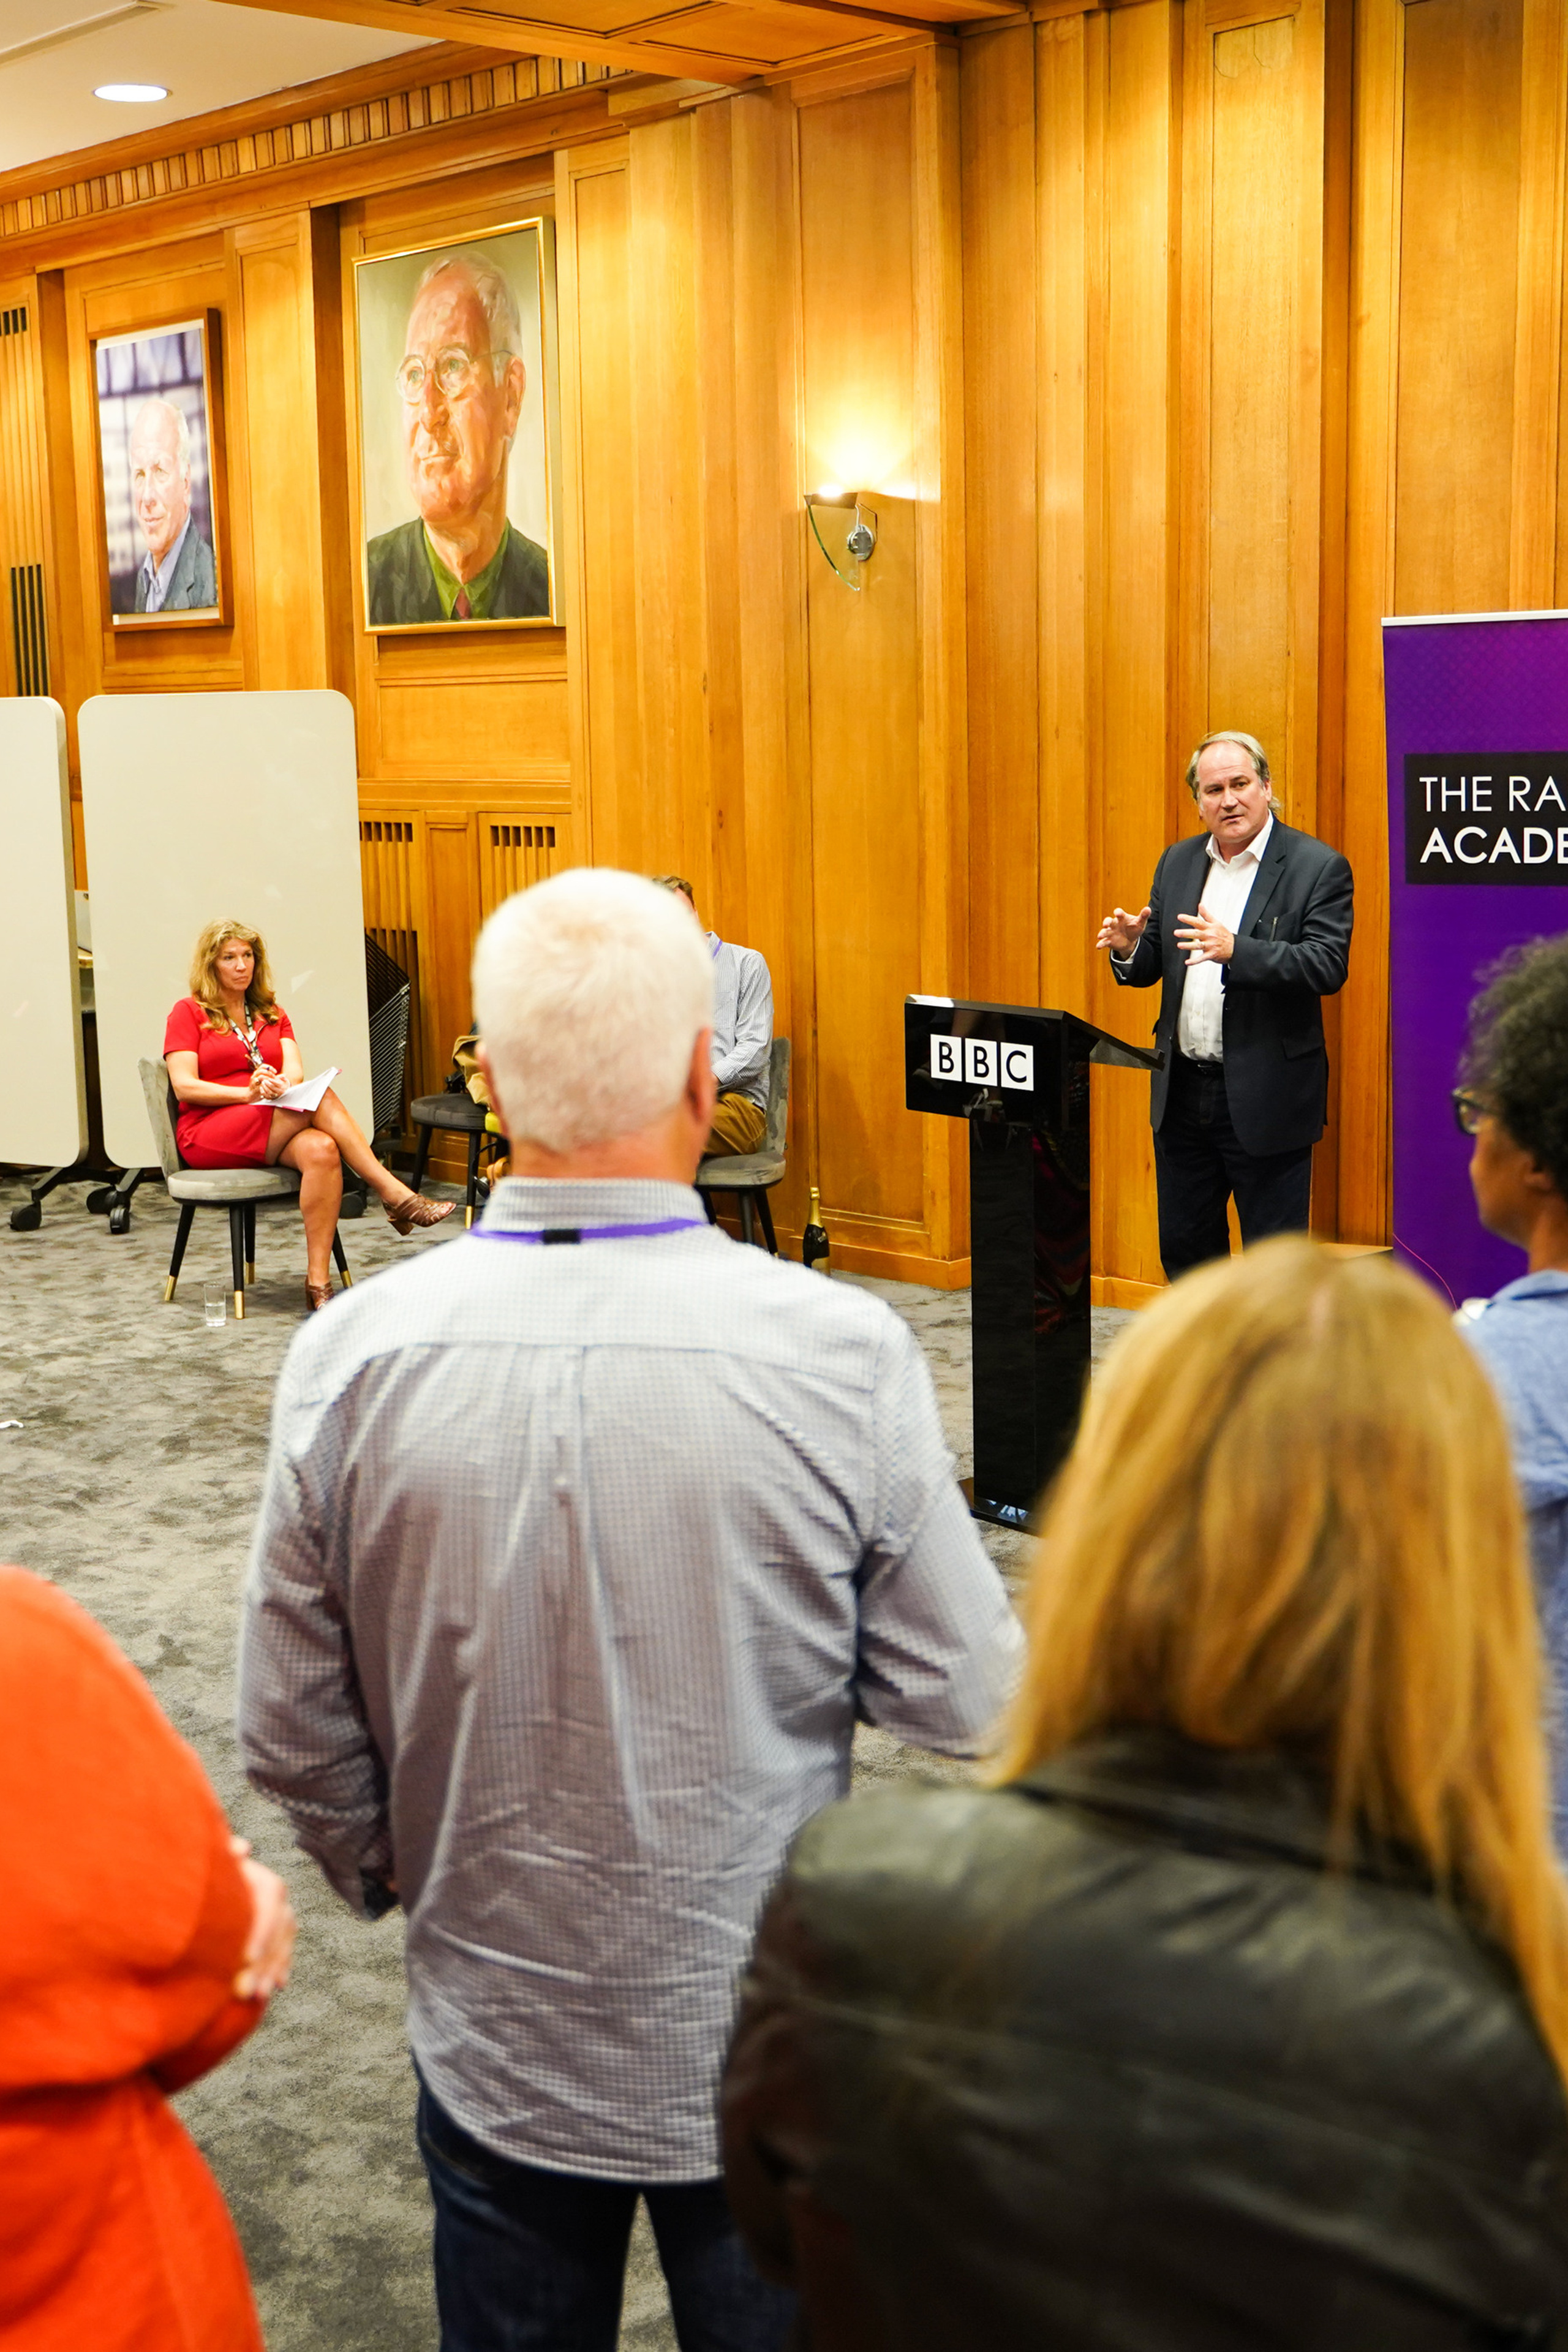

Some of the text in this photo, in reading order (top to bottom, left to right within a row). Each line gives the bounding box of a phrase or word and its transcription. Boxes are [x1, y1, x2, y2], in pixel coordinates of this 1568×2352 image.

[1419, 775, 1567, 812] THE RA
[938, 1041, 1027, 1084] BBC
